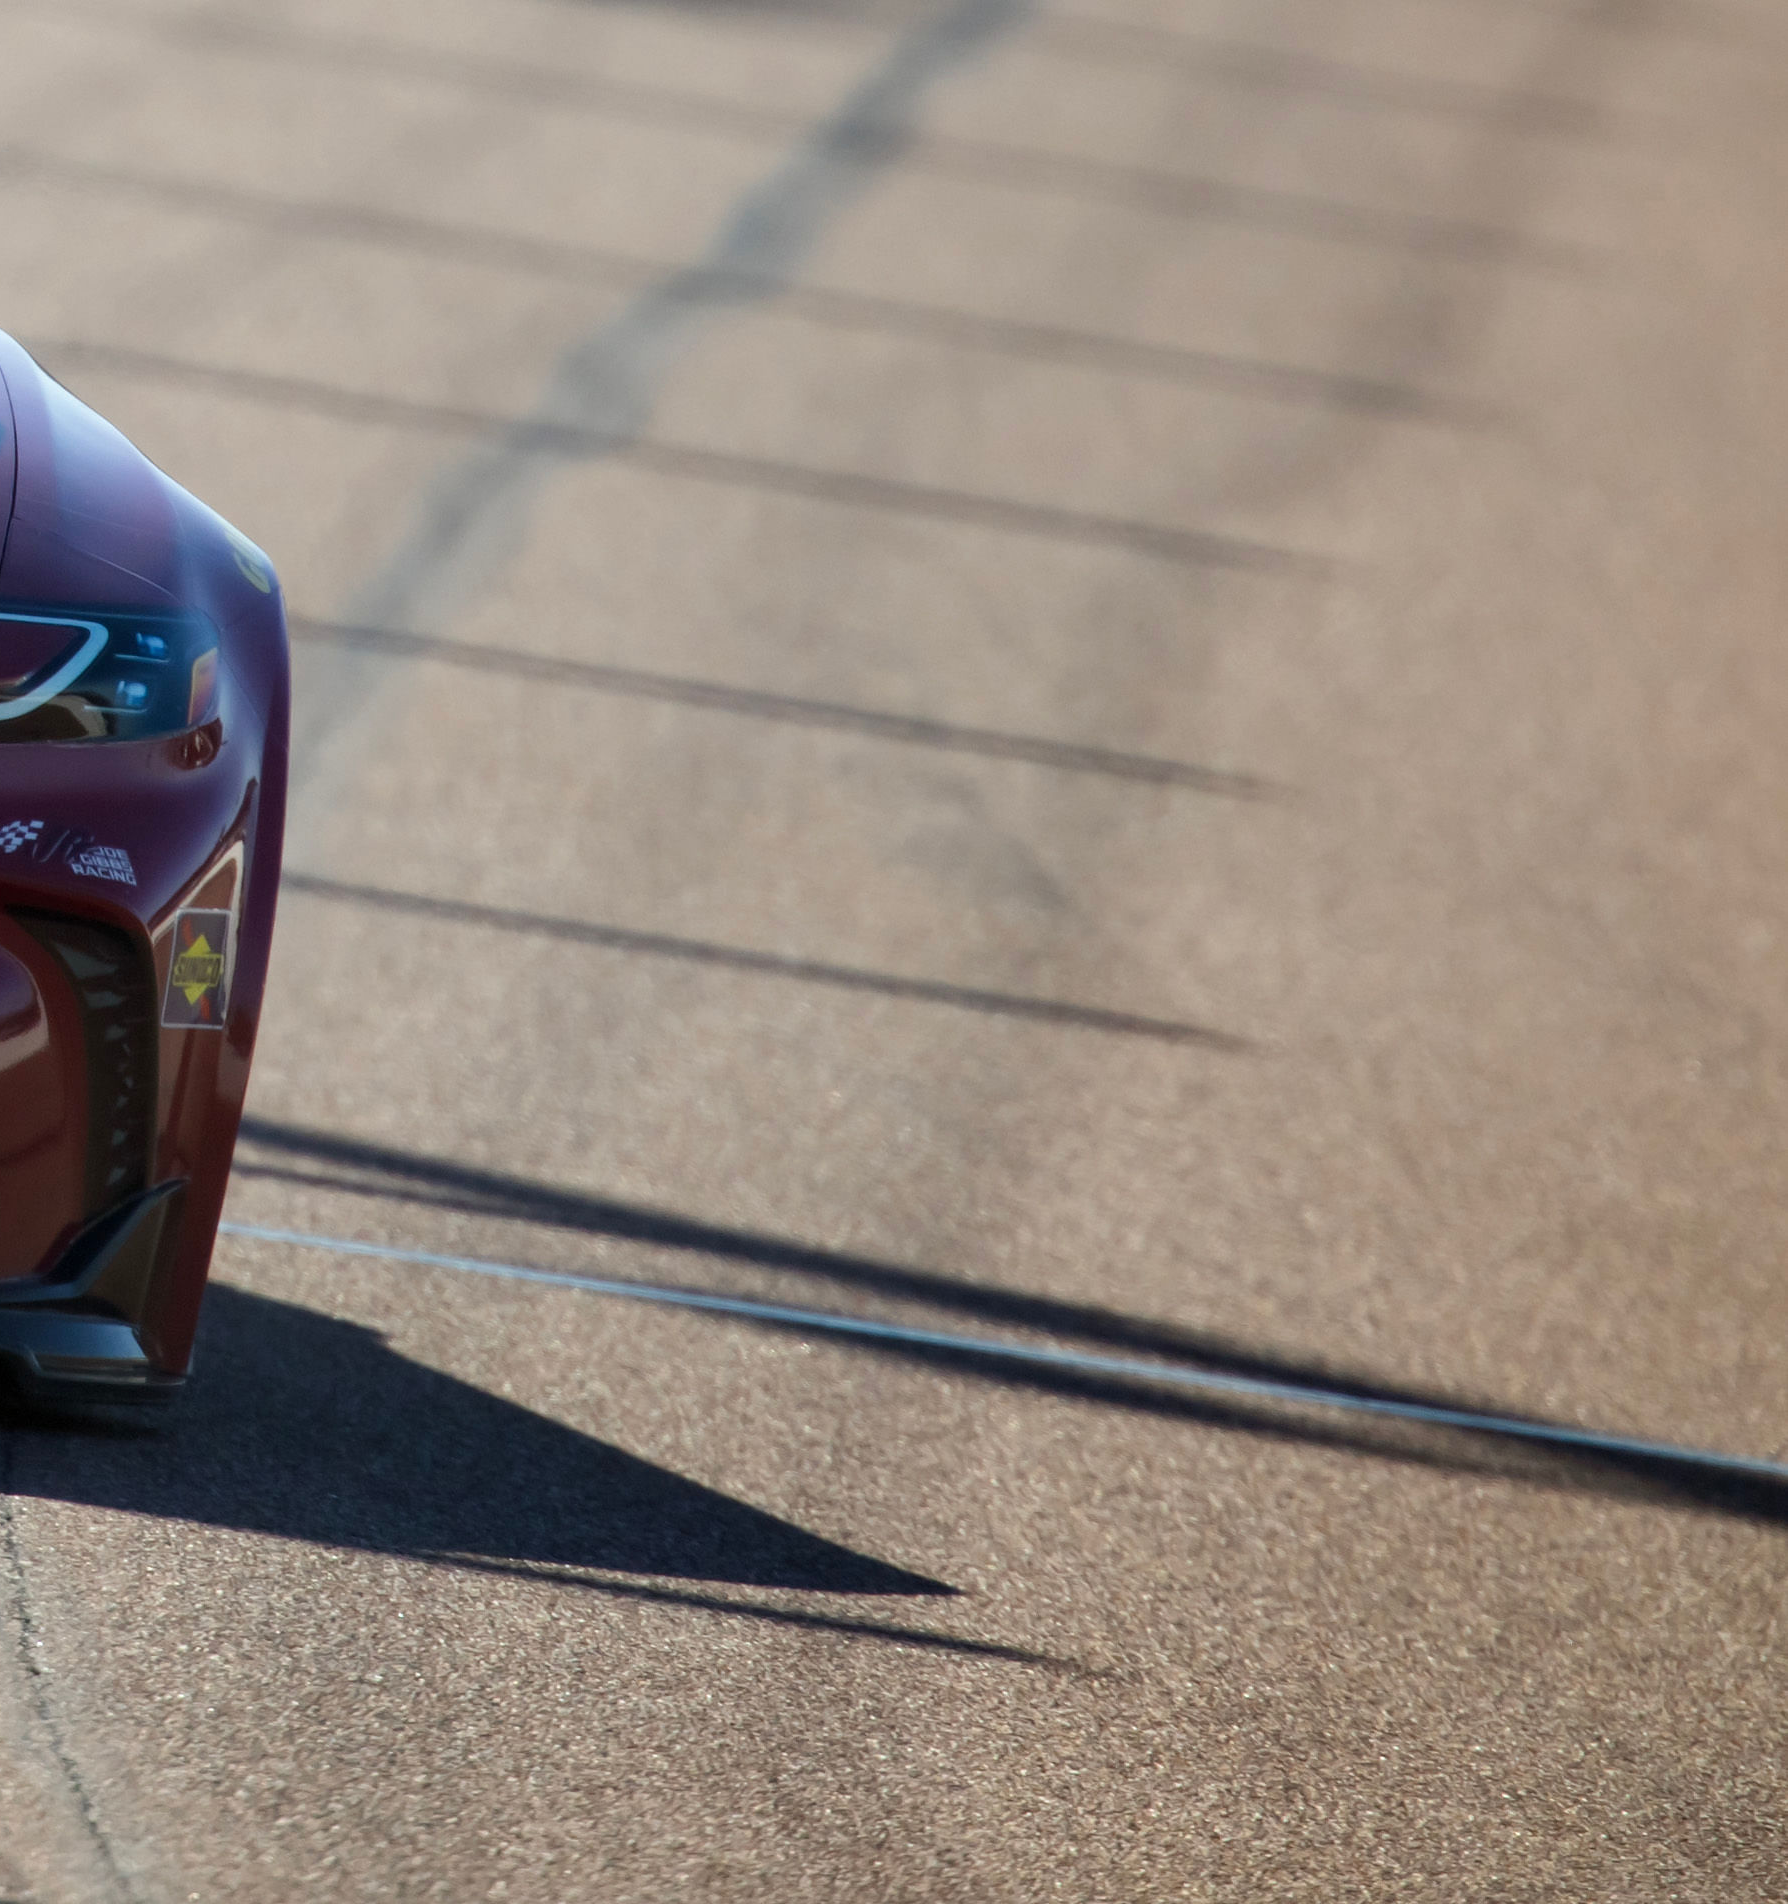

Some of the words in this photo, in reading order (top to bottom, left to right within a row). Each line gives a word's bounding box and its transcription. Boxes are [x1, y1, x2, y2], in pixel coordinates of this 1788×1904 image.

[78, 853, 133, 873] GIBBS
[92, 846, 129, 860] JOE
[70, 863, 138, 887] RACING
